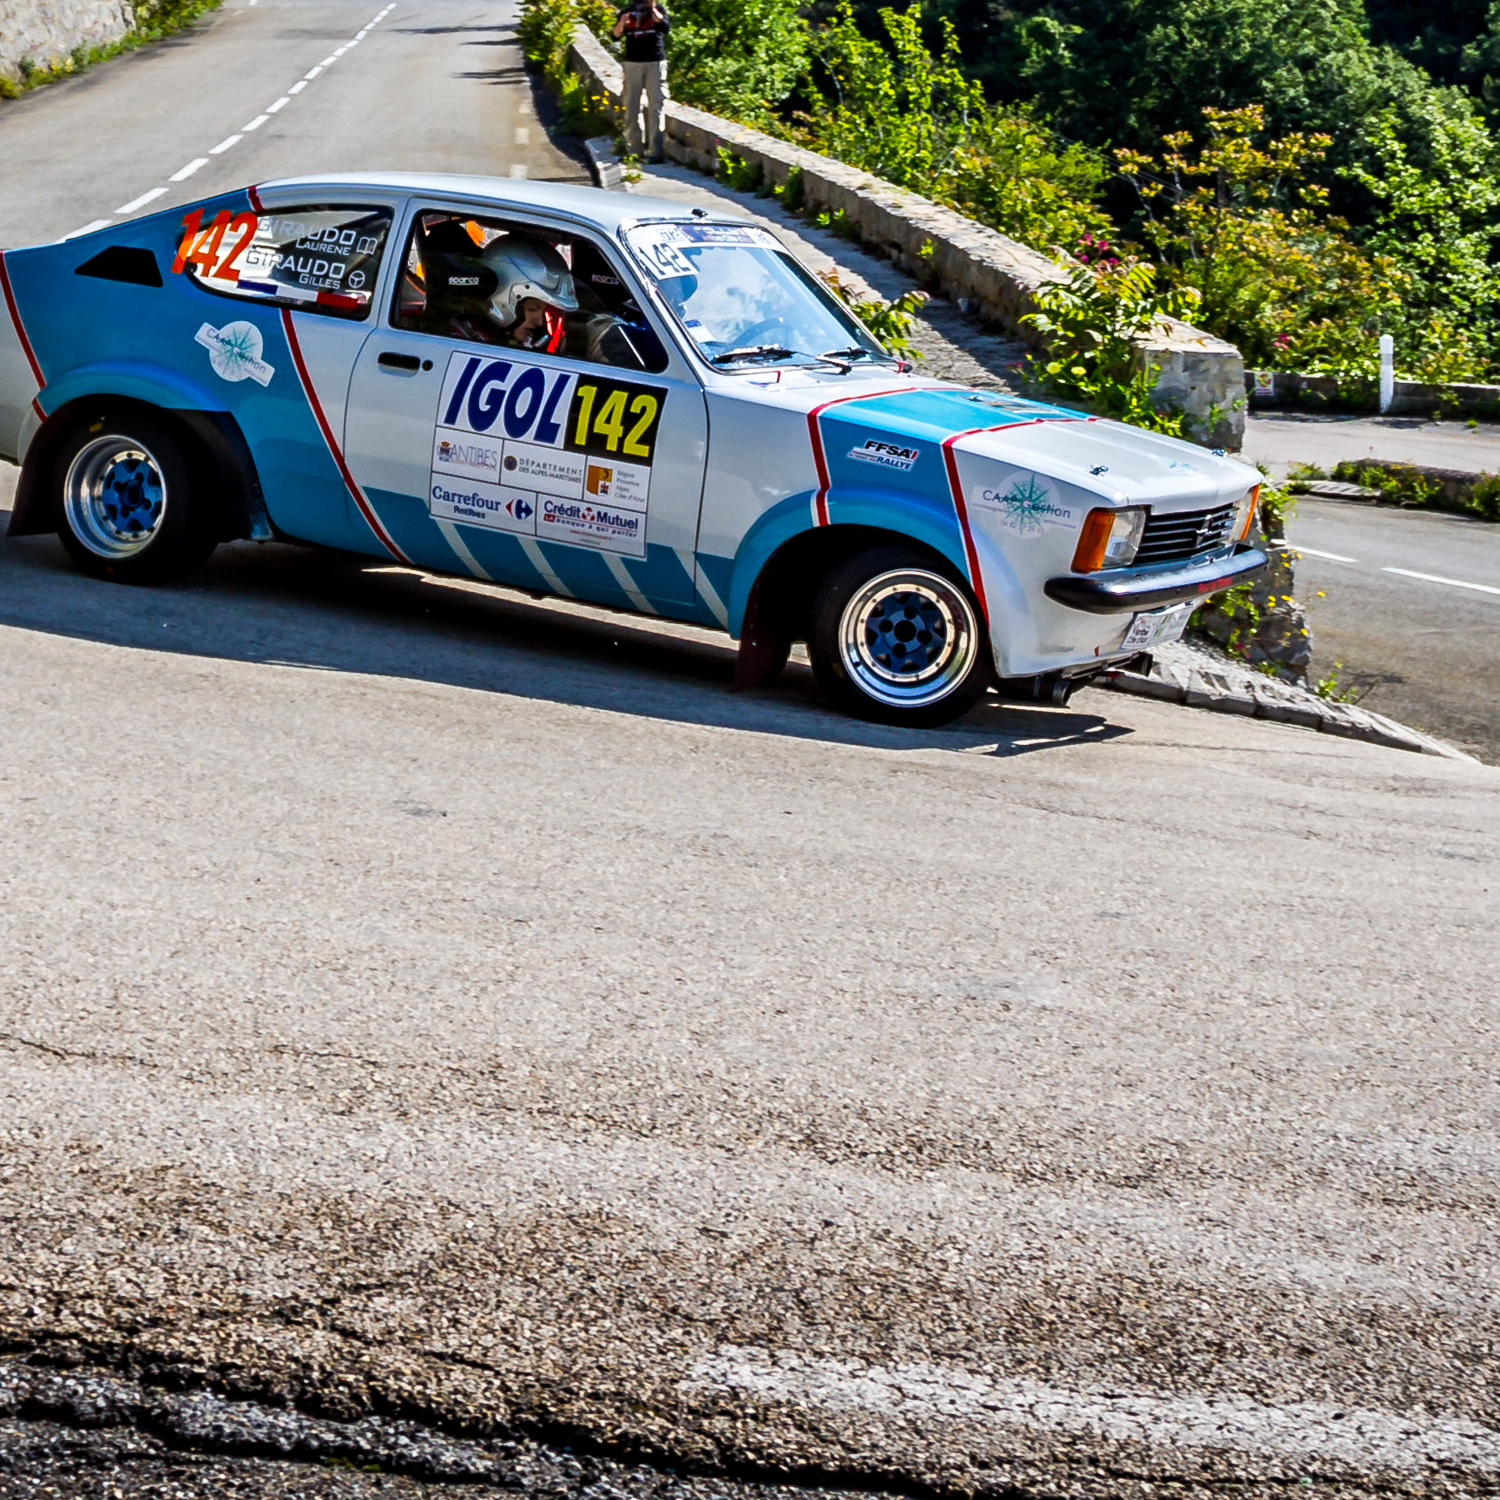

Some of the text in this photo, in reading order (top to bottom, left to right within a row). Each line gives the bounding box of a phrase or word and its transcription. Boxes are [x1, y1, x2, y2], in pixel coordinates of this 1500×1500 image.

[258, 218, 356, 246] GIRAUDO
[170, 207, 259, 282] 142
[295, 235, 351, 256] LAURENE
[246, 252, 346, 279] GIRAUDO
[638, 243, 692, 275] 142
[299, 273, 341, 290] GILLES
[448, 276, 479, 285] sparco
[443, 357, 572, 445] IGOL
[574, 385, 659, 458] 142
[449, 444, 498, 469] ANTIBES
[864, 440, 912, 459] FFSA
[518, 466, 530, 474] DES
[519, 458, 582, 476] DÉPARTEMENT
[876, 456, 912, 470] RALLYE
[431, 485, 502, 512] Carrefour
[1021, 498, 1071, 519] Gestion
[453, 504, 486, 519] Antibes
[543, 500, 639, 530] Crédit Mutuel
[556, 517, 586, 528] banque
[596, 525, 609, 533] qui
[611, 528, 638, 538] parler
